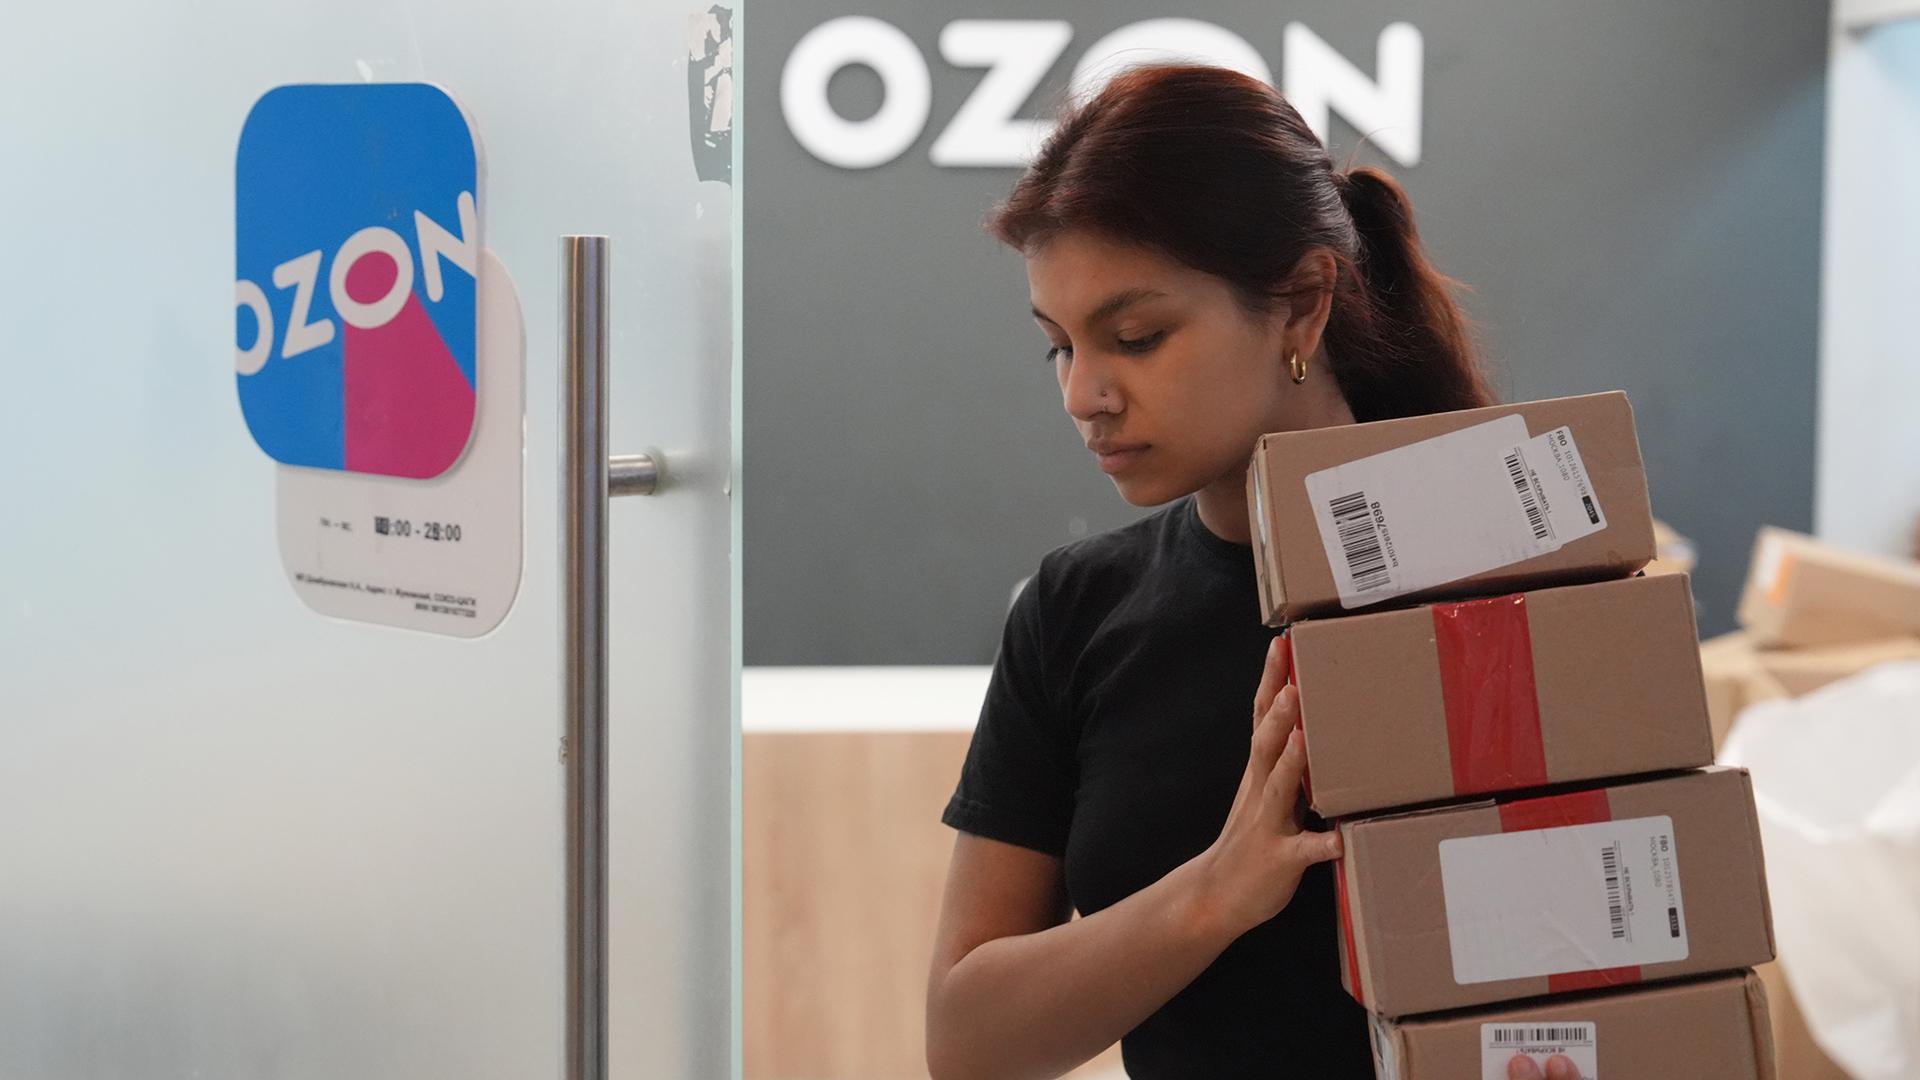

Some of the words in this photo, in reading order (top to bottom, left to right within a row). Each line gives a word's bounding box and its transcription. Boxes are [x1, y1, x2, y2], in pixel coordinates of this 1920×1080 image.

[235, 191, 477, 377] OZON
[1555, 429, 1568, 447] FBO
[1660, 835, 1668, 852] FBO
